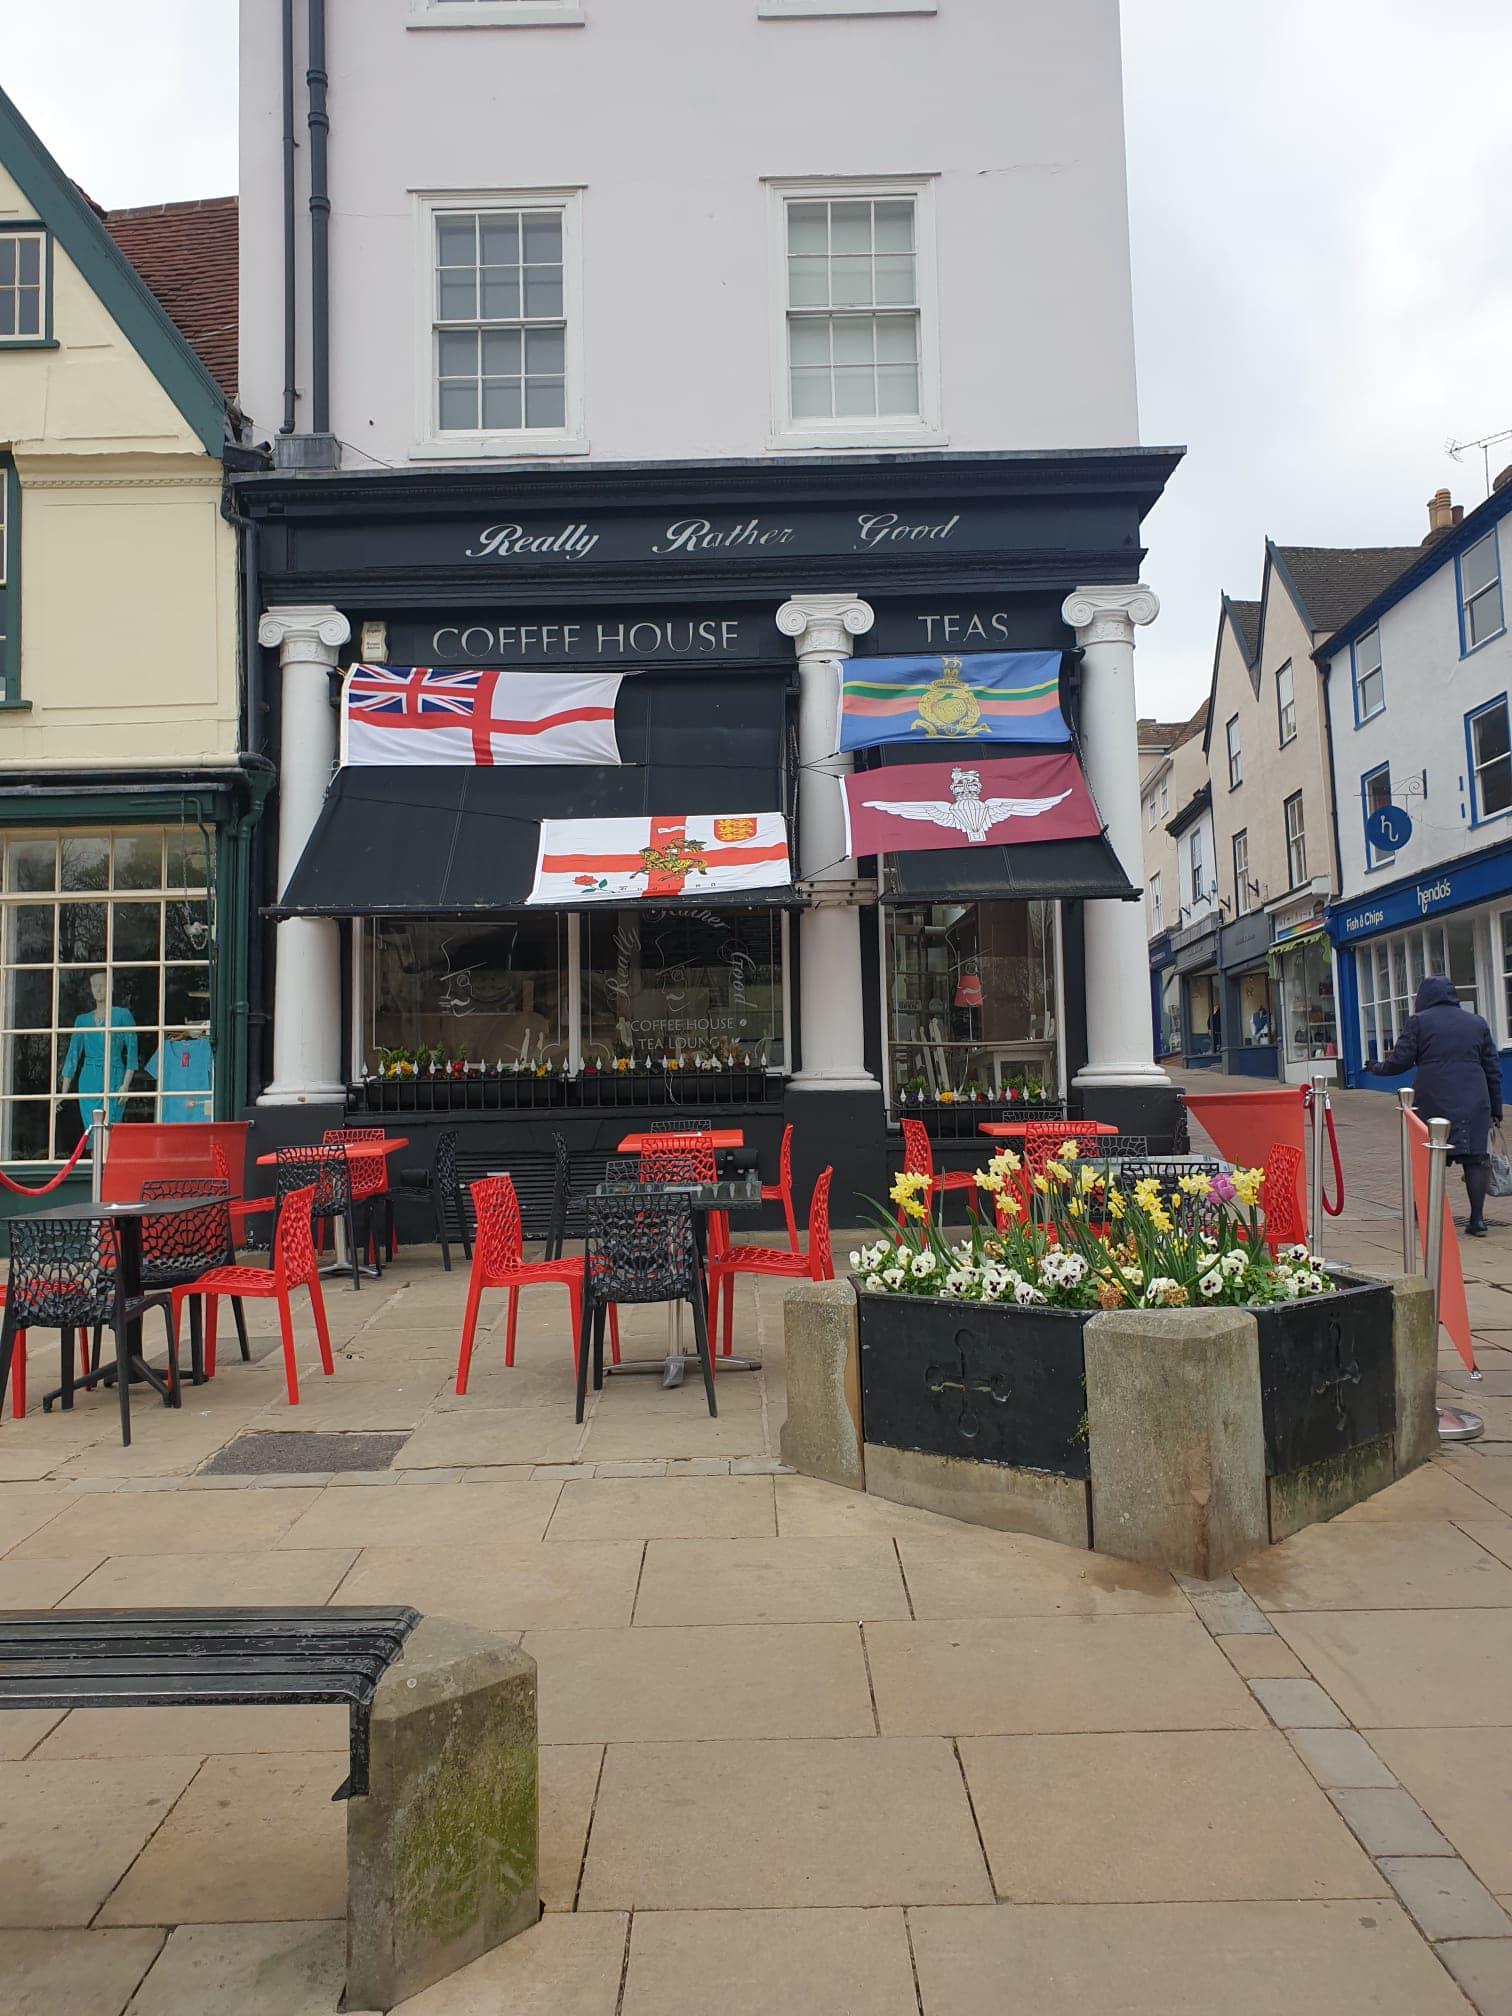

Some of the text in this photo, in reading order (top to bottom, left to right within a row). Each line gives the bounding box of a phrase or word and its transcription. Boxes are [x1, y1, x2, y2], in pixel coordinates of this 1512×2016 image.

[465, 513, 961, 560] Really Rather Good
[432, 620, 739, 657] COFFEE HOUSE
[917, 612, 1009, 643] TEAS
[1416, 878, 1451, 914] hendo's
[1346, 917, 1359, 932] Fish
[1364, 910, 1384, 927] Chips
[631, 1017, 734, 1032] COFFEE HOUSE
[638, 1037, 721, 1050] TEA LOUNG
